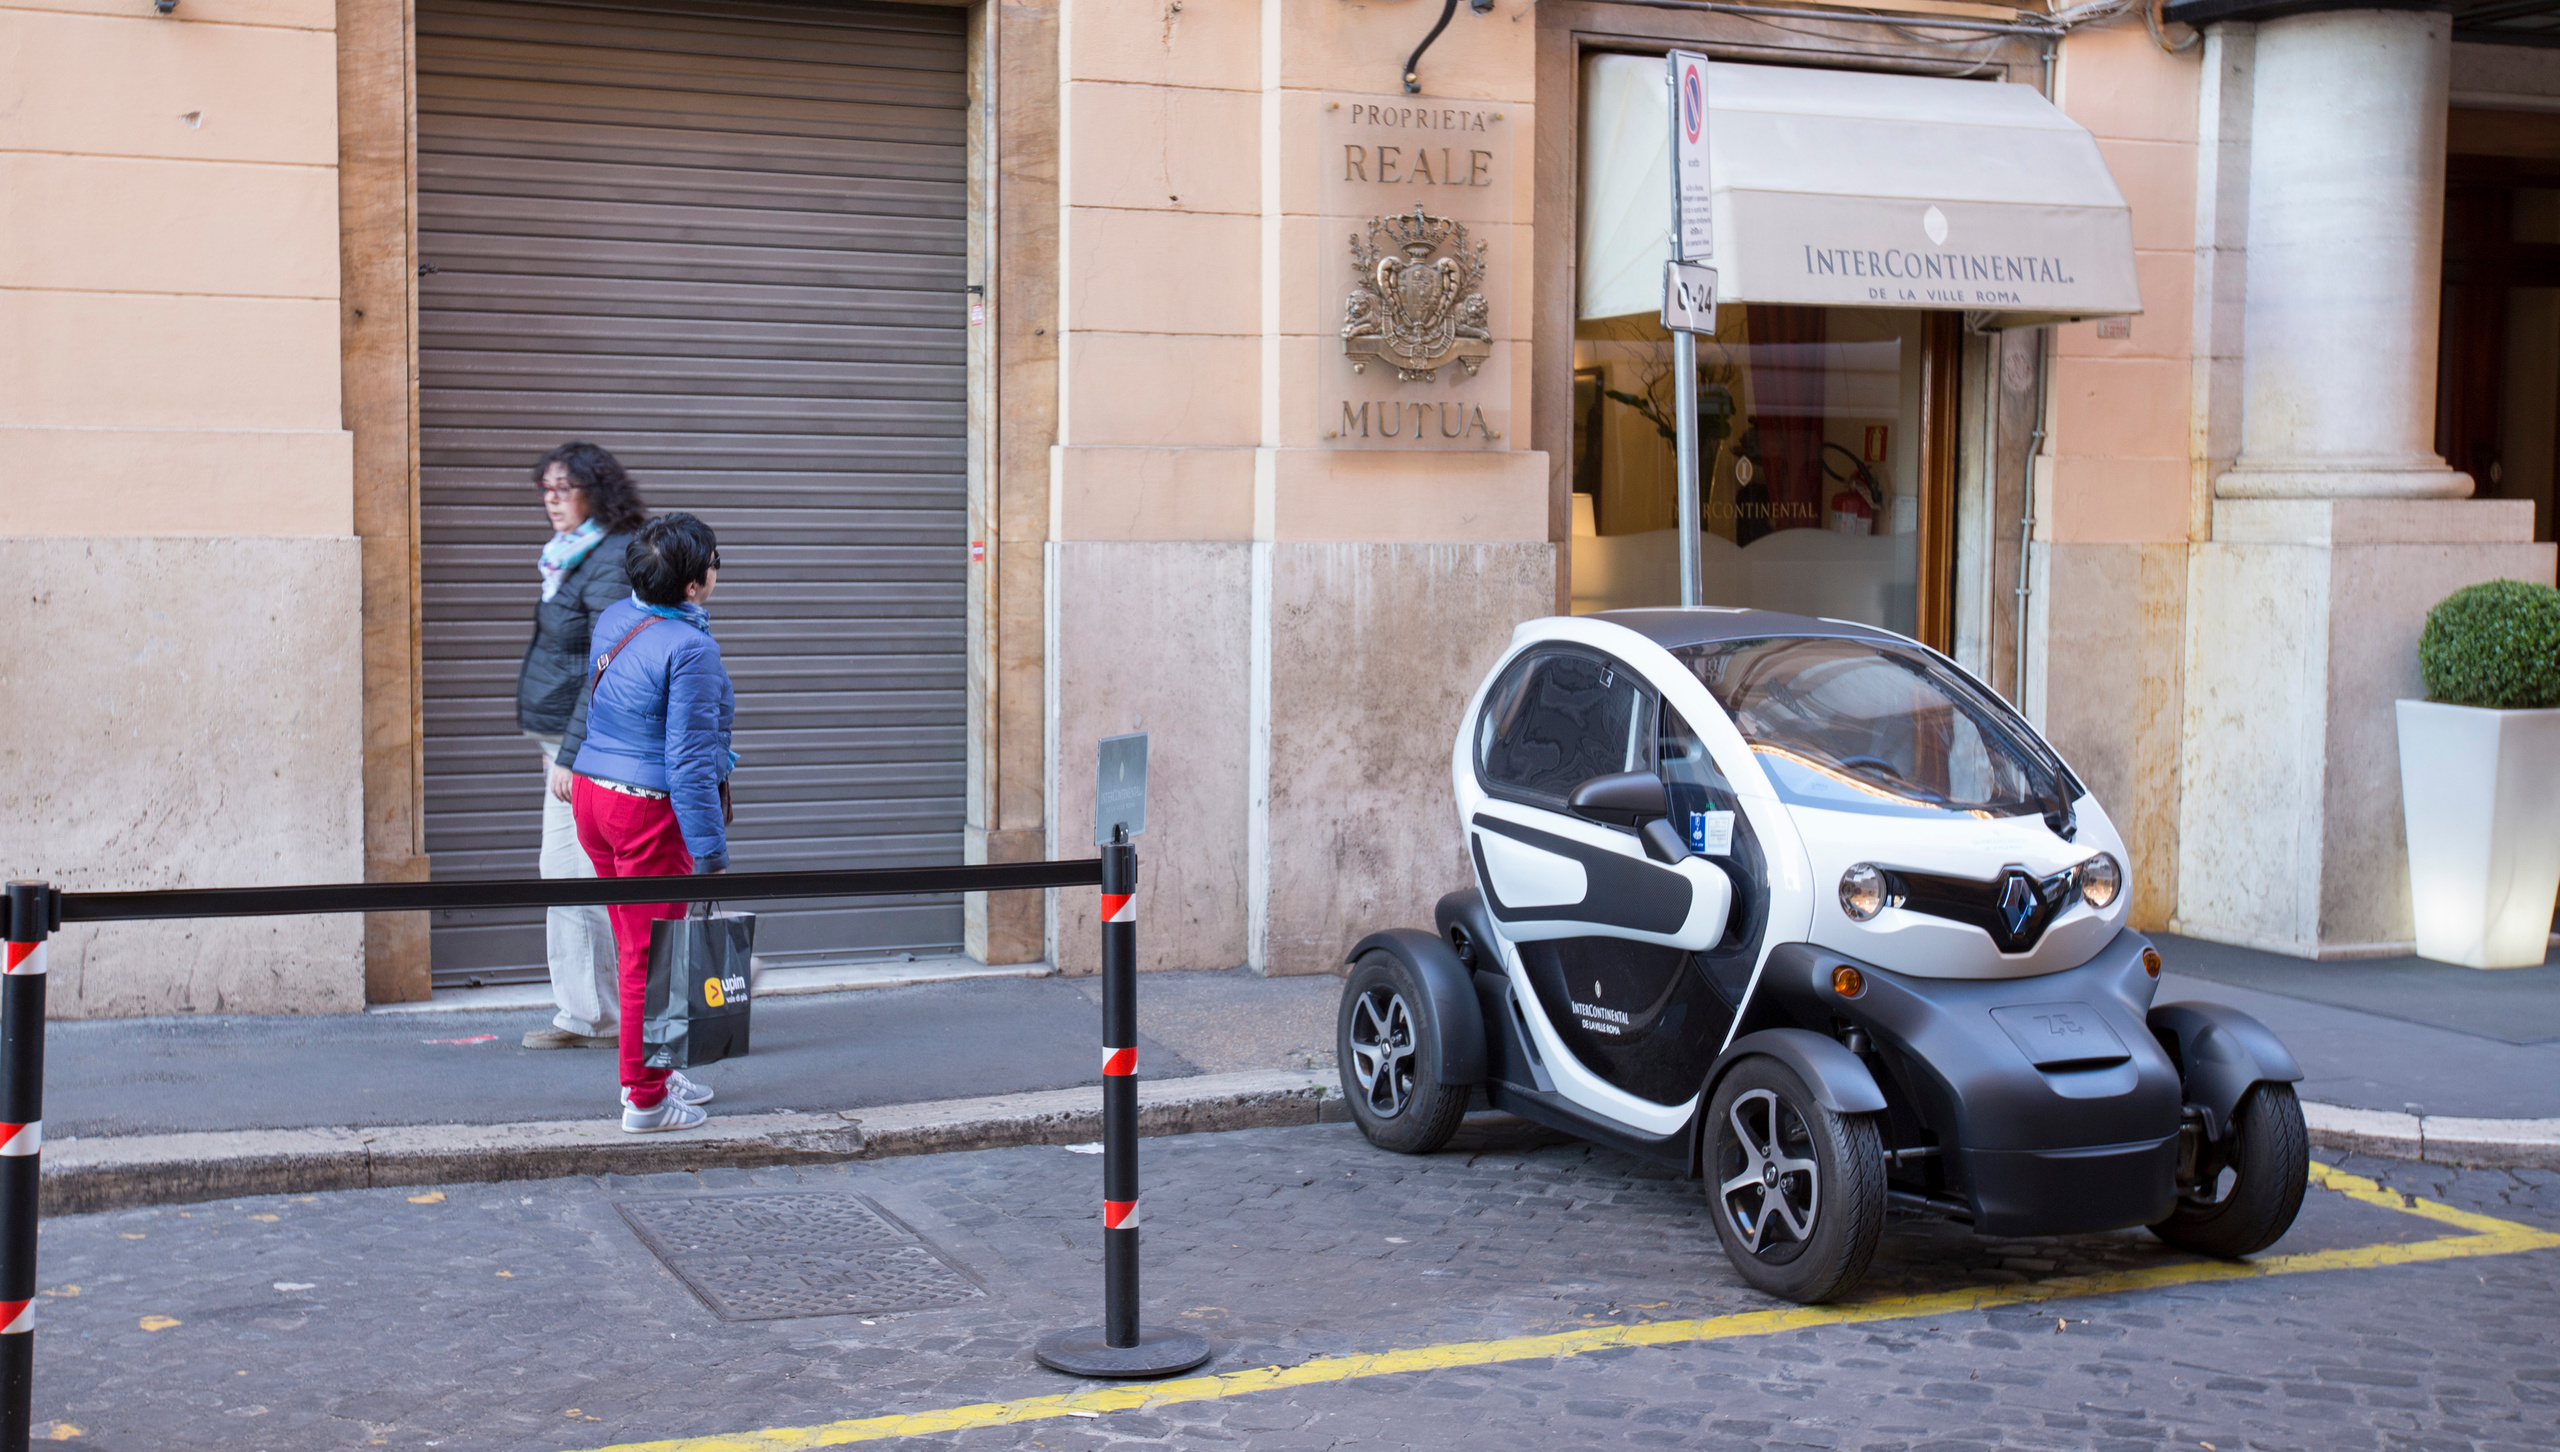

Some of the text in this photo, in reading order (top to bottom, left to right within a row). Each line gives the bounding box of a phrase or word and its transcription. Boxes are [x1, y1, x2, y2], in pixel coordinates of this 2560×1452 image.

[1343, 144, 1494, 188] REALE
[1868, 287, 2022, 304] DE LA VILLE ROMA
[1340, 400, 1494, 439] MUTUA
[721, 973, 746, 995] upim
[1606, 1023, 1621, 1036] ROMA
